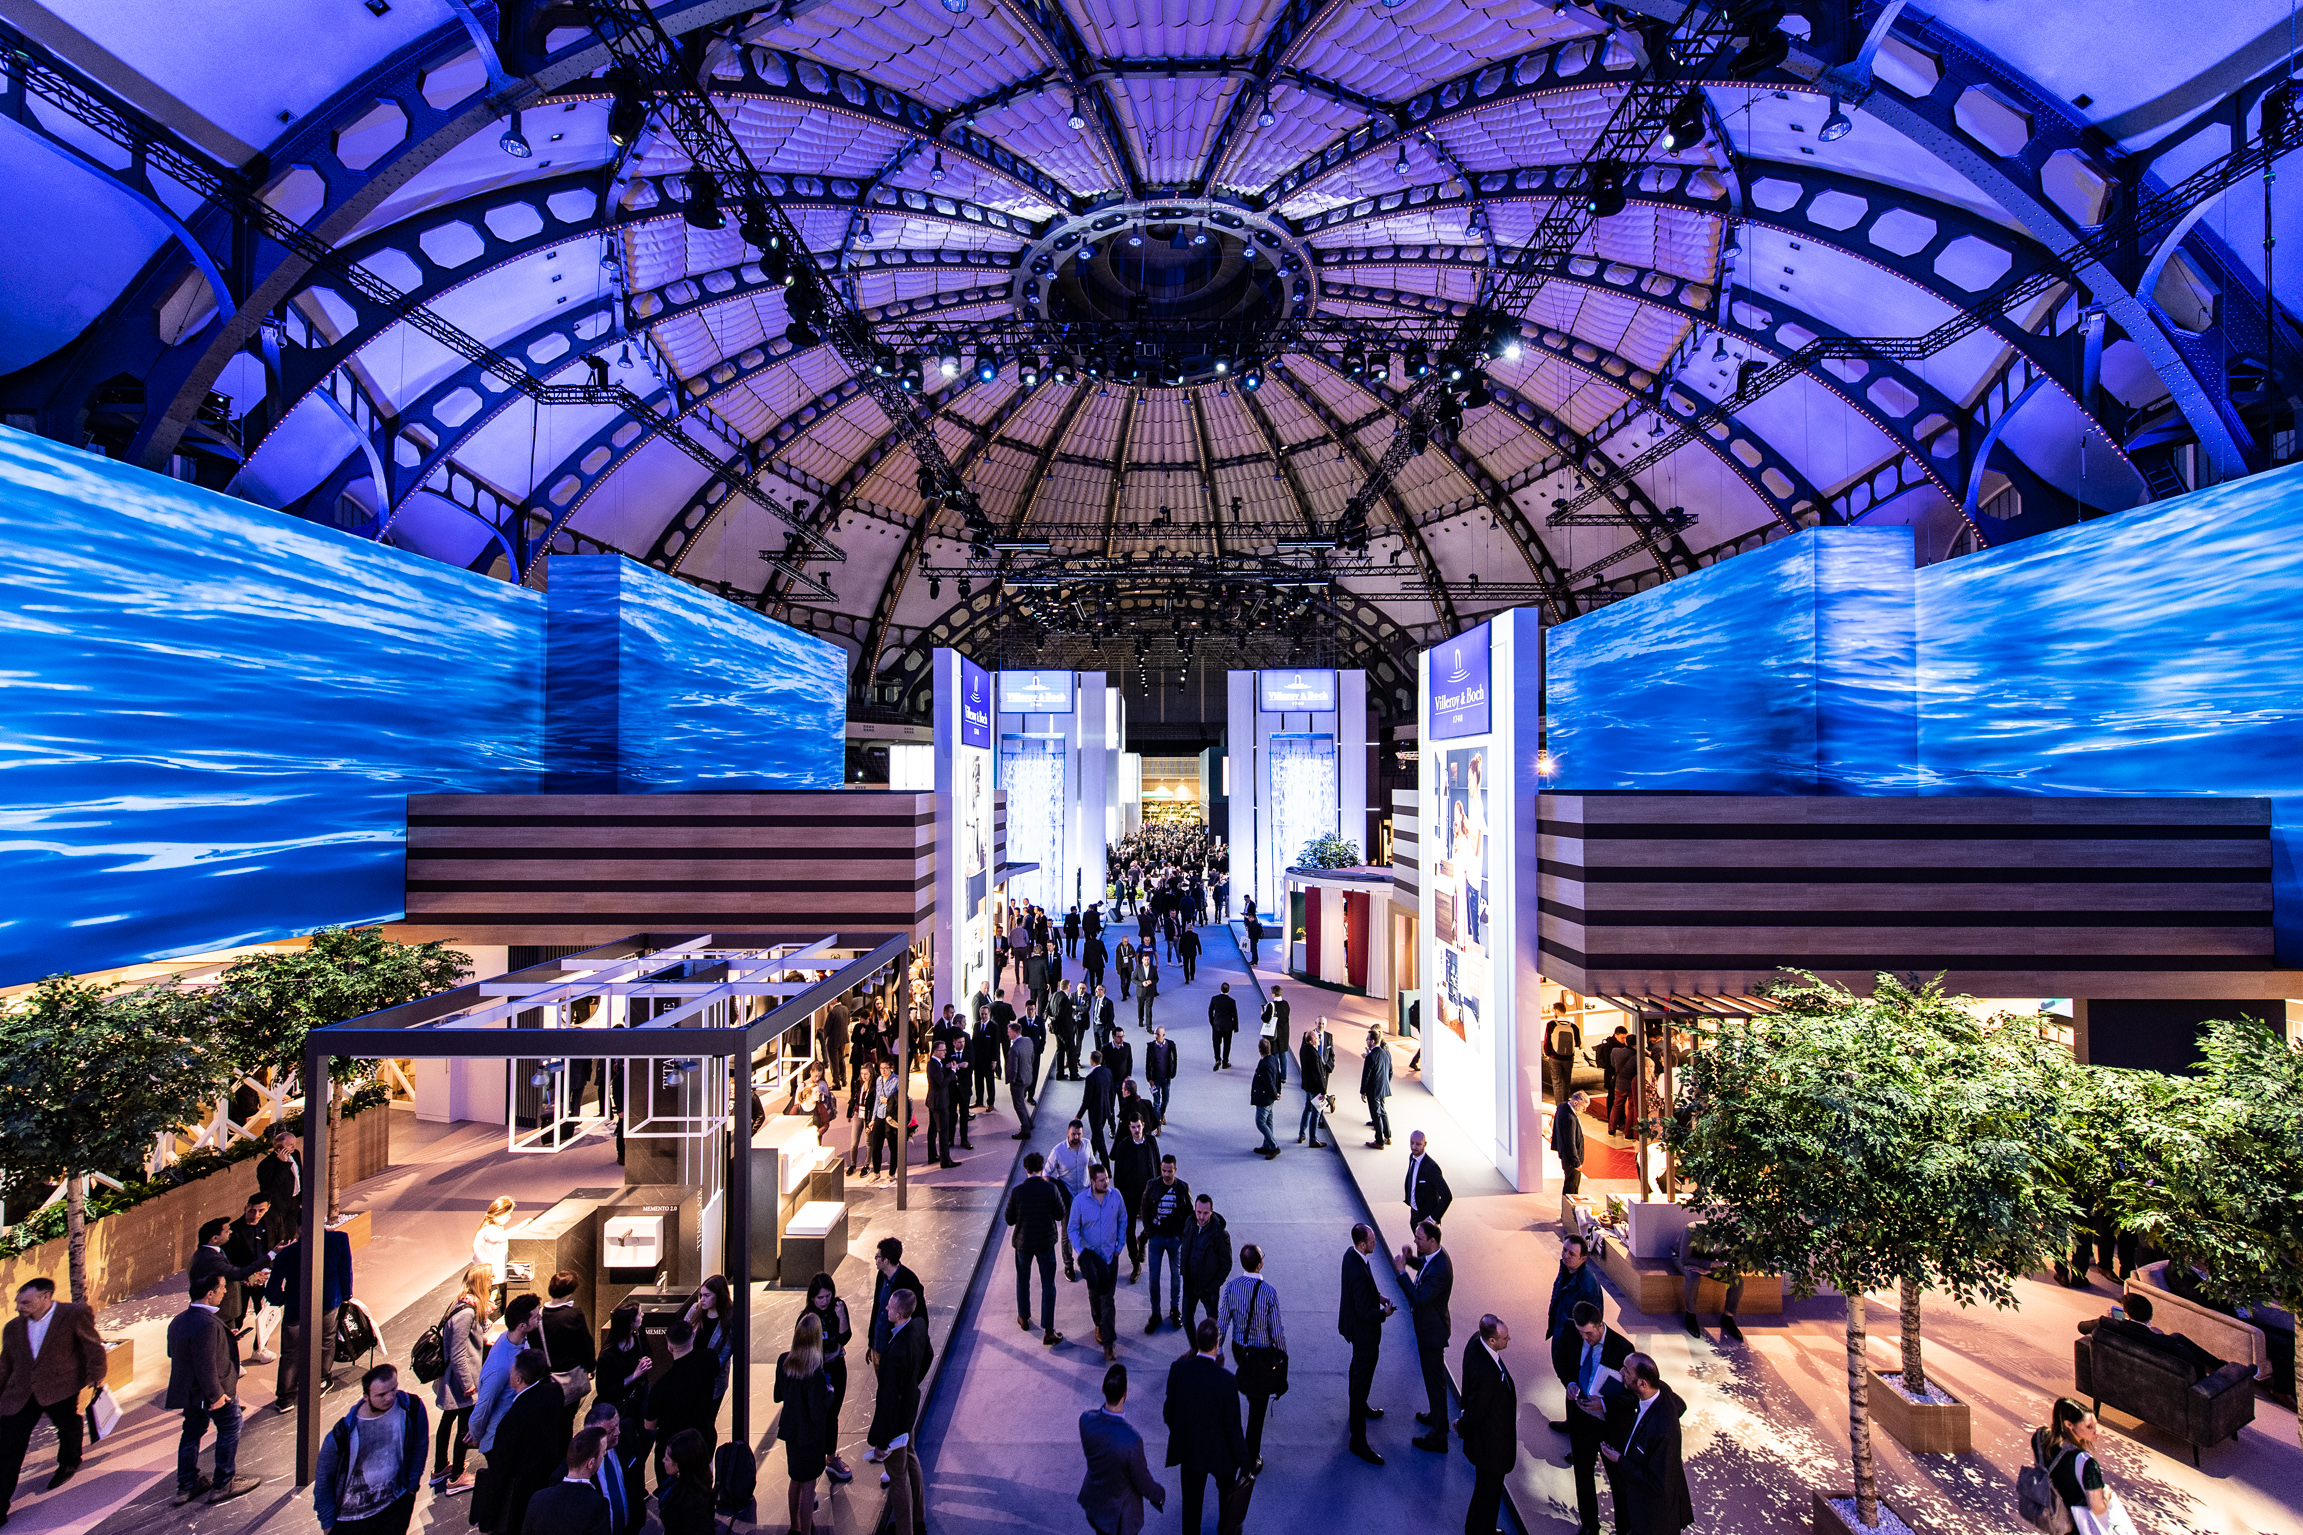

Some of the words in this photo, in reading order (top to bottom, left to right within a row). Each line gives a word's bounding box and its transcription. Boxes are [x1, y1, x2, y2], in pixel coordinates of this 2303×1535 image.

[1045, 692, 1066, 701] Boch
[1268, 691, 1299, 701] Villeroy
[1308, 691, 1328, 700] Boch
[1434, 693, 1460, 711] Villeroy
[1460, 691, 1466, 705] &
[1466, 683, 1484, 704] Boch
[1452, 714, 1463, 724] 1748
